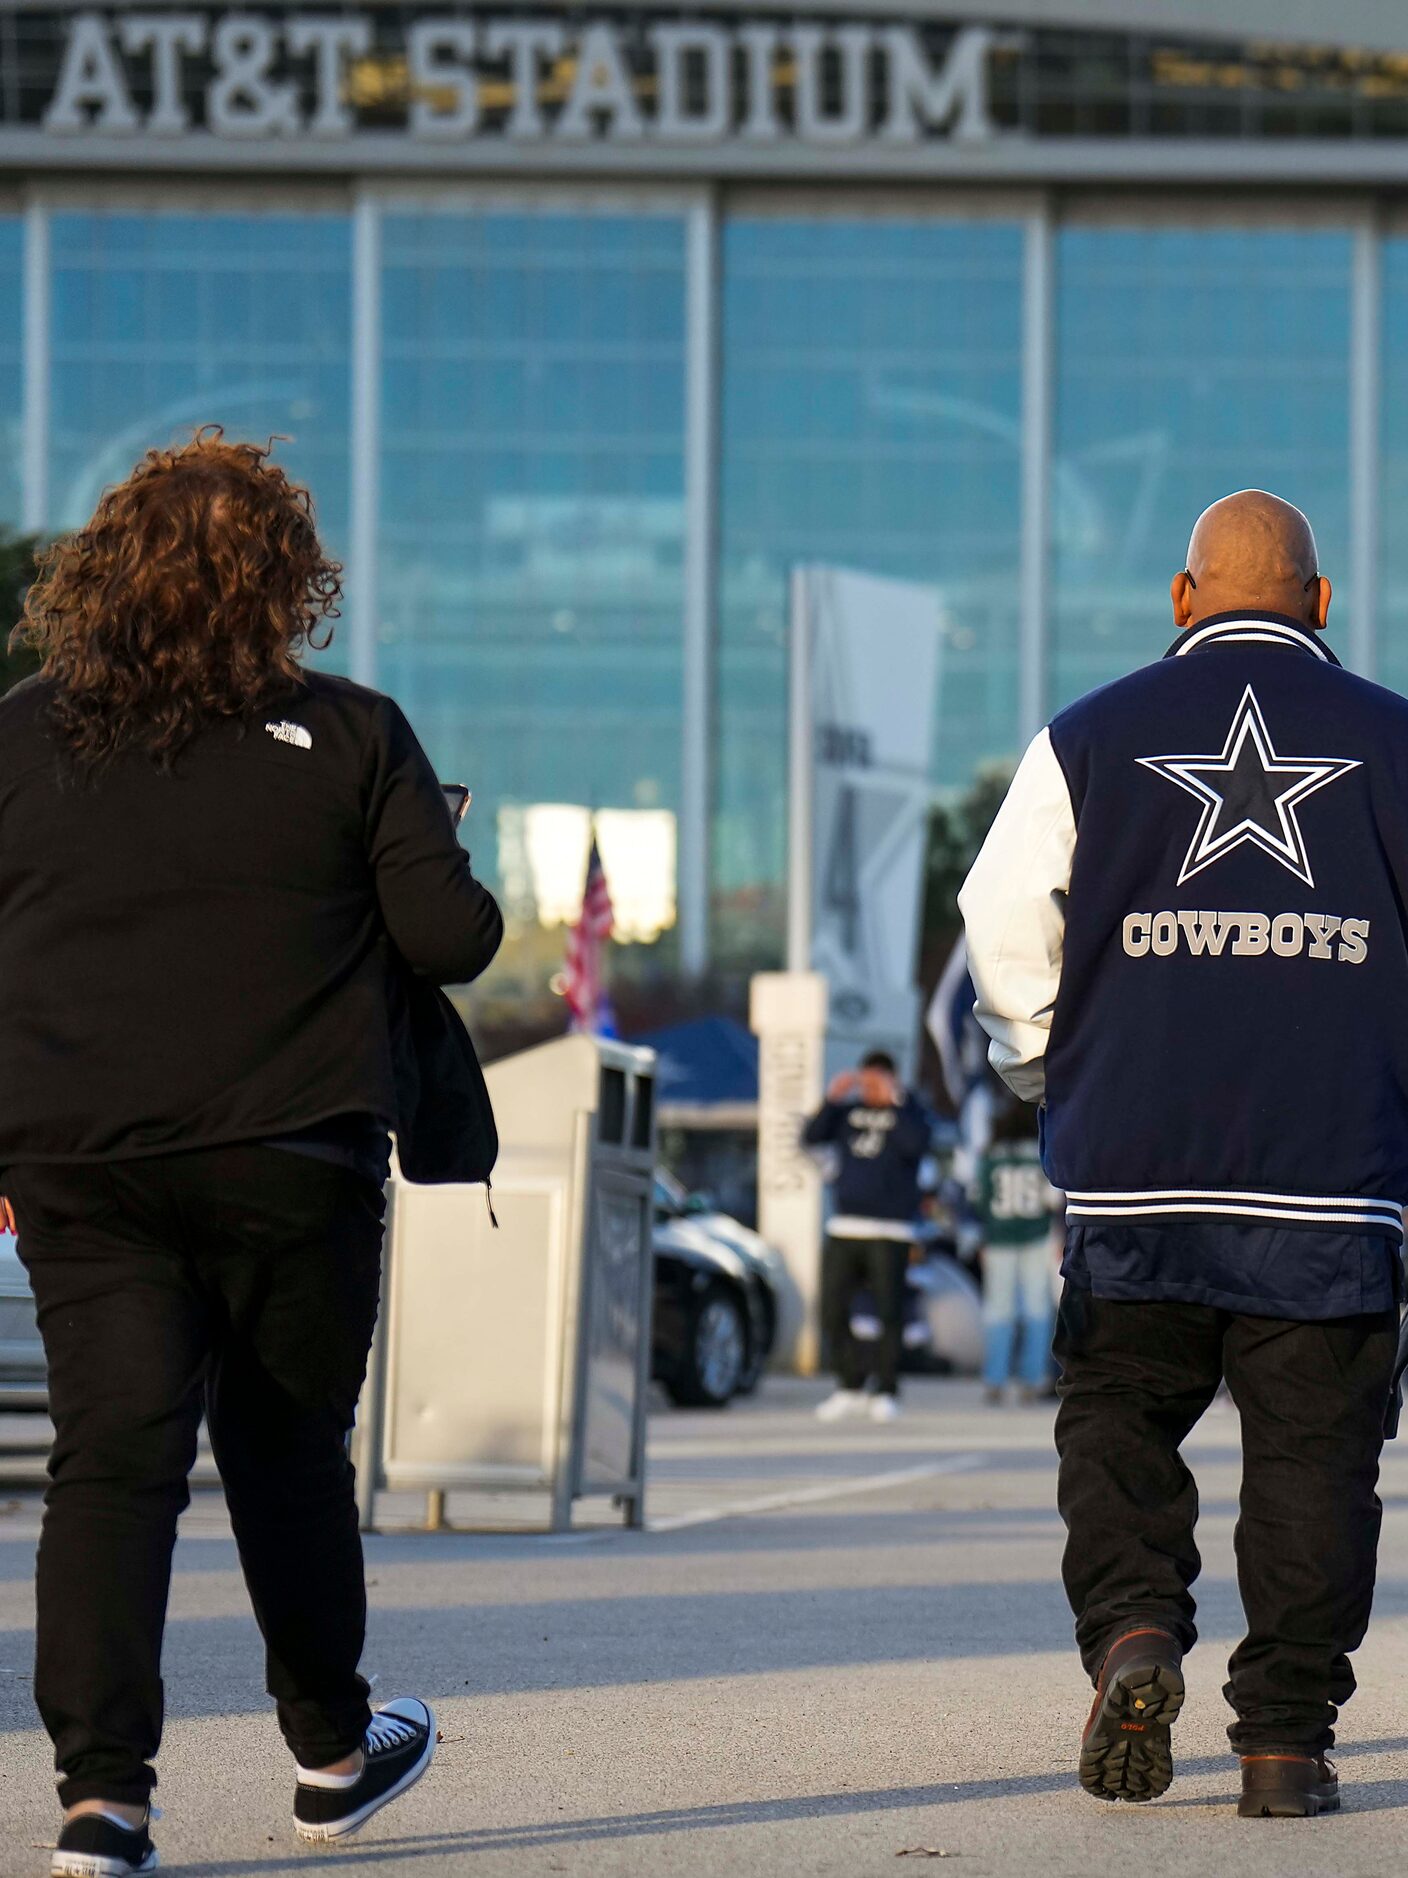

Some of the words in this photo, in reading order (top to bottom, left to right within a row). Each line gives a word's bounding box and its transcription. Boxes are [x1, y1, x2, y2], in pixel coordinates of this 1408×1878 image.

[43, 15, 371, 140] AT&T
[406, 18, 992, 144] STADIUM
[1122, 910, 1370, 964] COWBOYS
